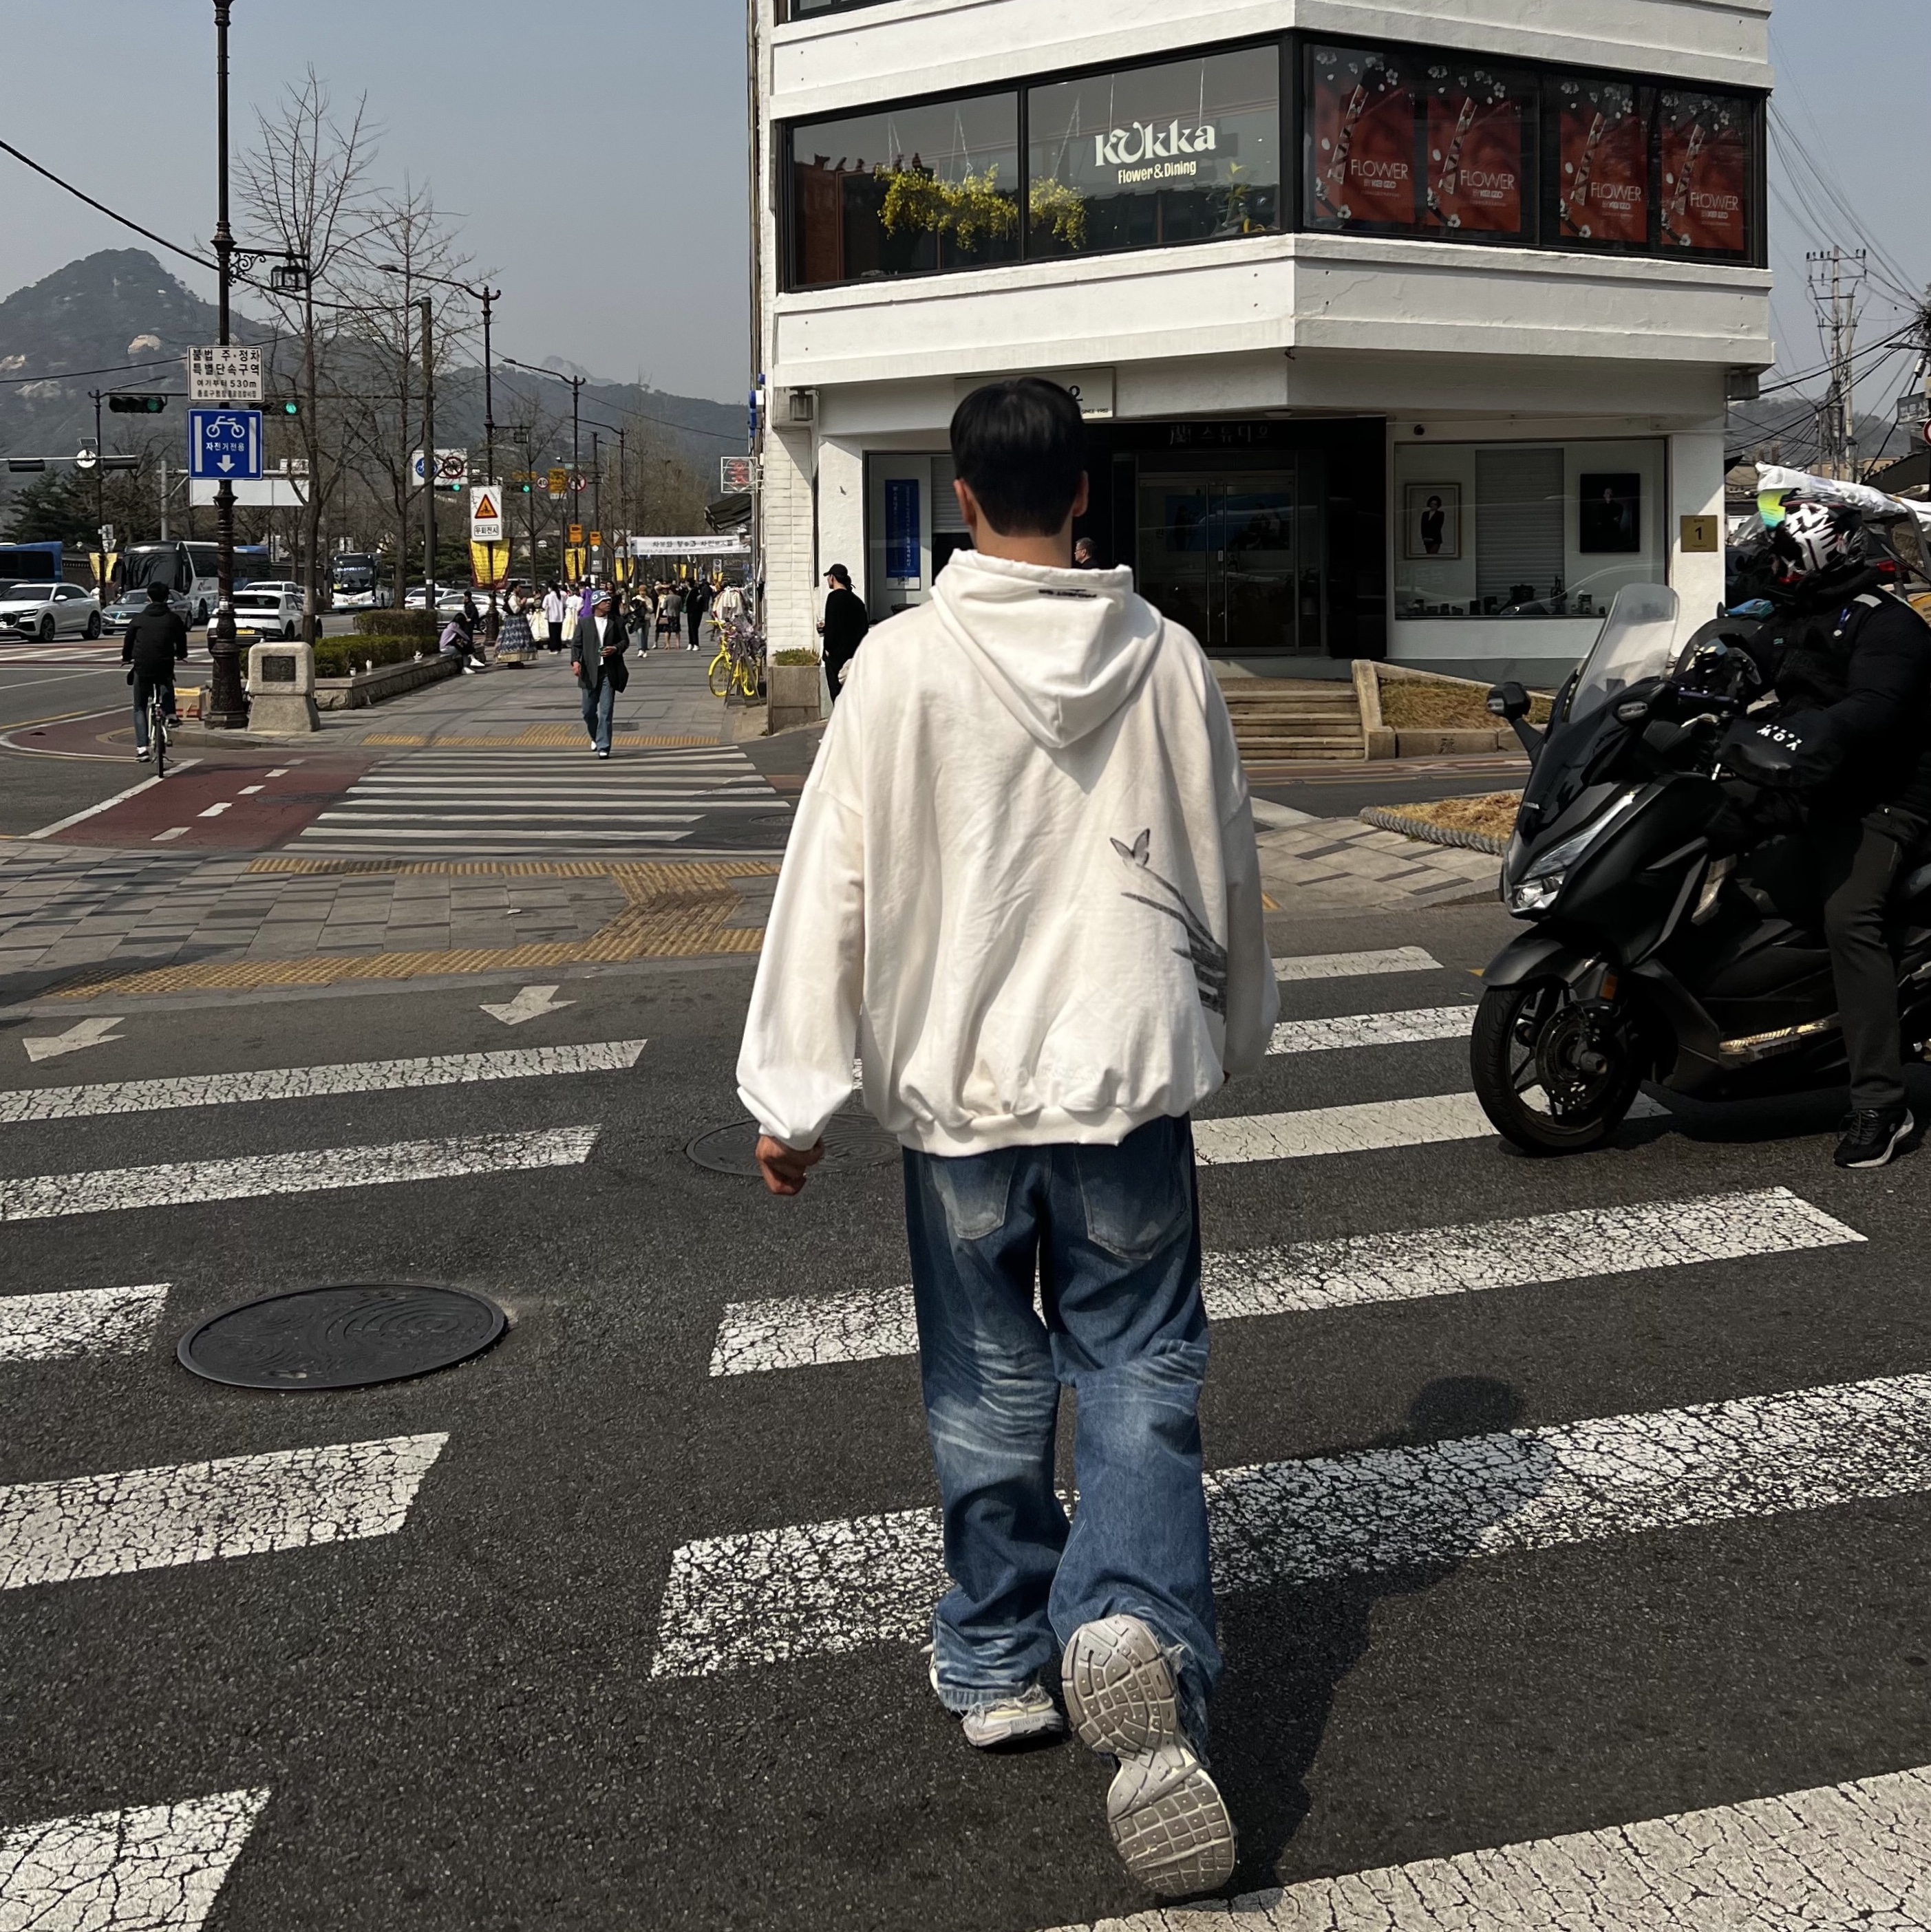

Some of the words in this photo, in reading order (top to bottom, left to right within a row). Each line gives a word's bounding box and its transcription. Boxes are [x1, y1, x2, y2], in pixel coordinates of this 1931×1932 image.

[1351, 159, 1408, 179] FLOWER
[1460, 169, 1515, 189] FLOWER
[1591, 182, 1641, 201] FLOWER
[1690, 192, 1739, 211] FLOWER
[193, 349, 213, 361] 불법
[1200, 425, 1270, 442] 스튜디오
[206, 442, 244, 451] 자전거전용
[1695, 526, 1702, 540] 1
